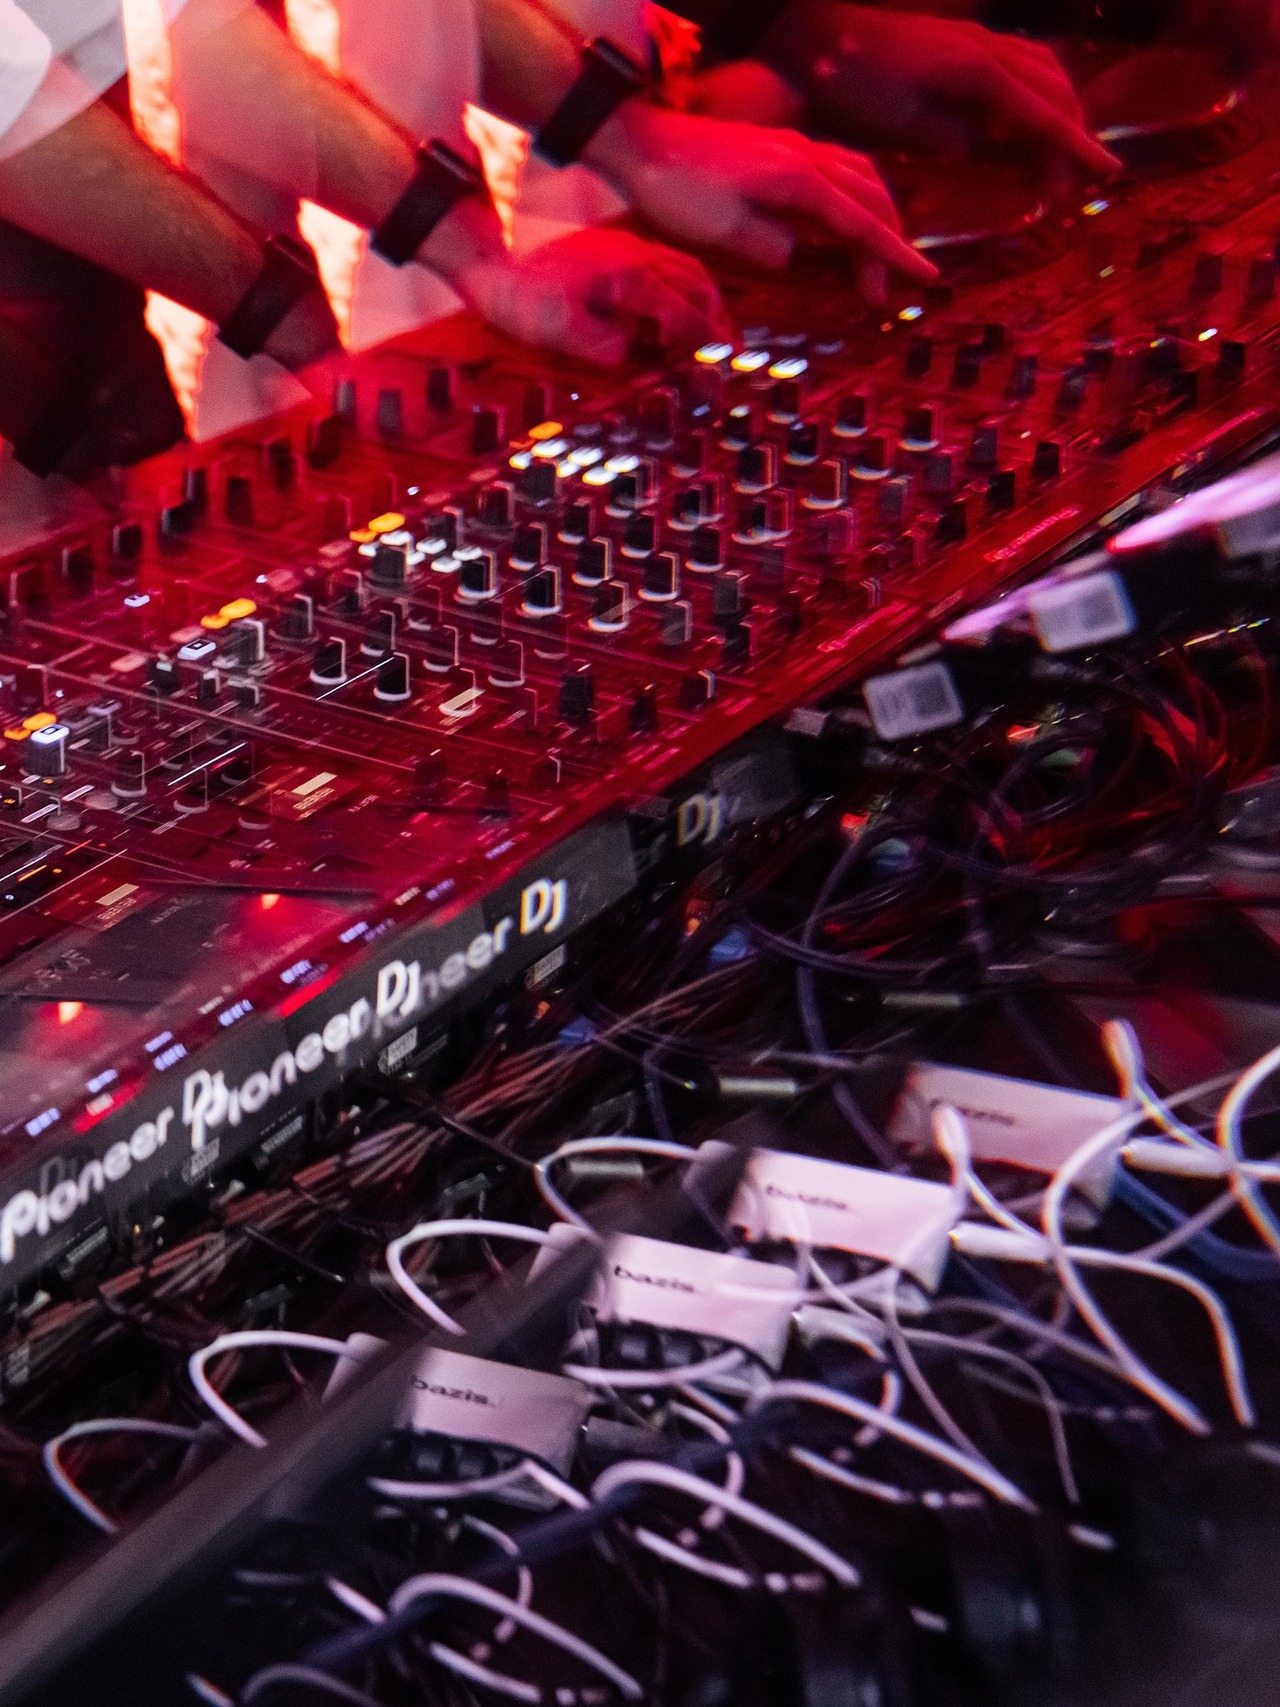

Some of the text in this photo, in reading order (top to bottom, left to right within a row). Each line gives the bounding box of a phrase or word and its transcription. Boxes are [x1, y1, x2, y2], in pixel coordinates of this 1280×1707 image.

[520, 877, 567, 935] DJ
[191, 997, 370, 1152] Pioneer
[376, 959, 420, 1018] DJ
[0, 1105, 175, 1264] Pioneer
